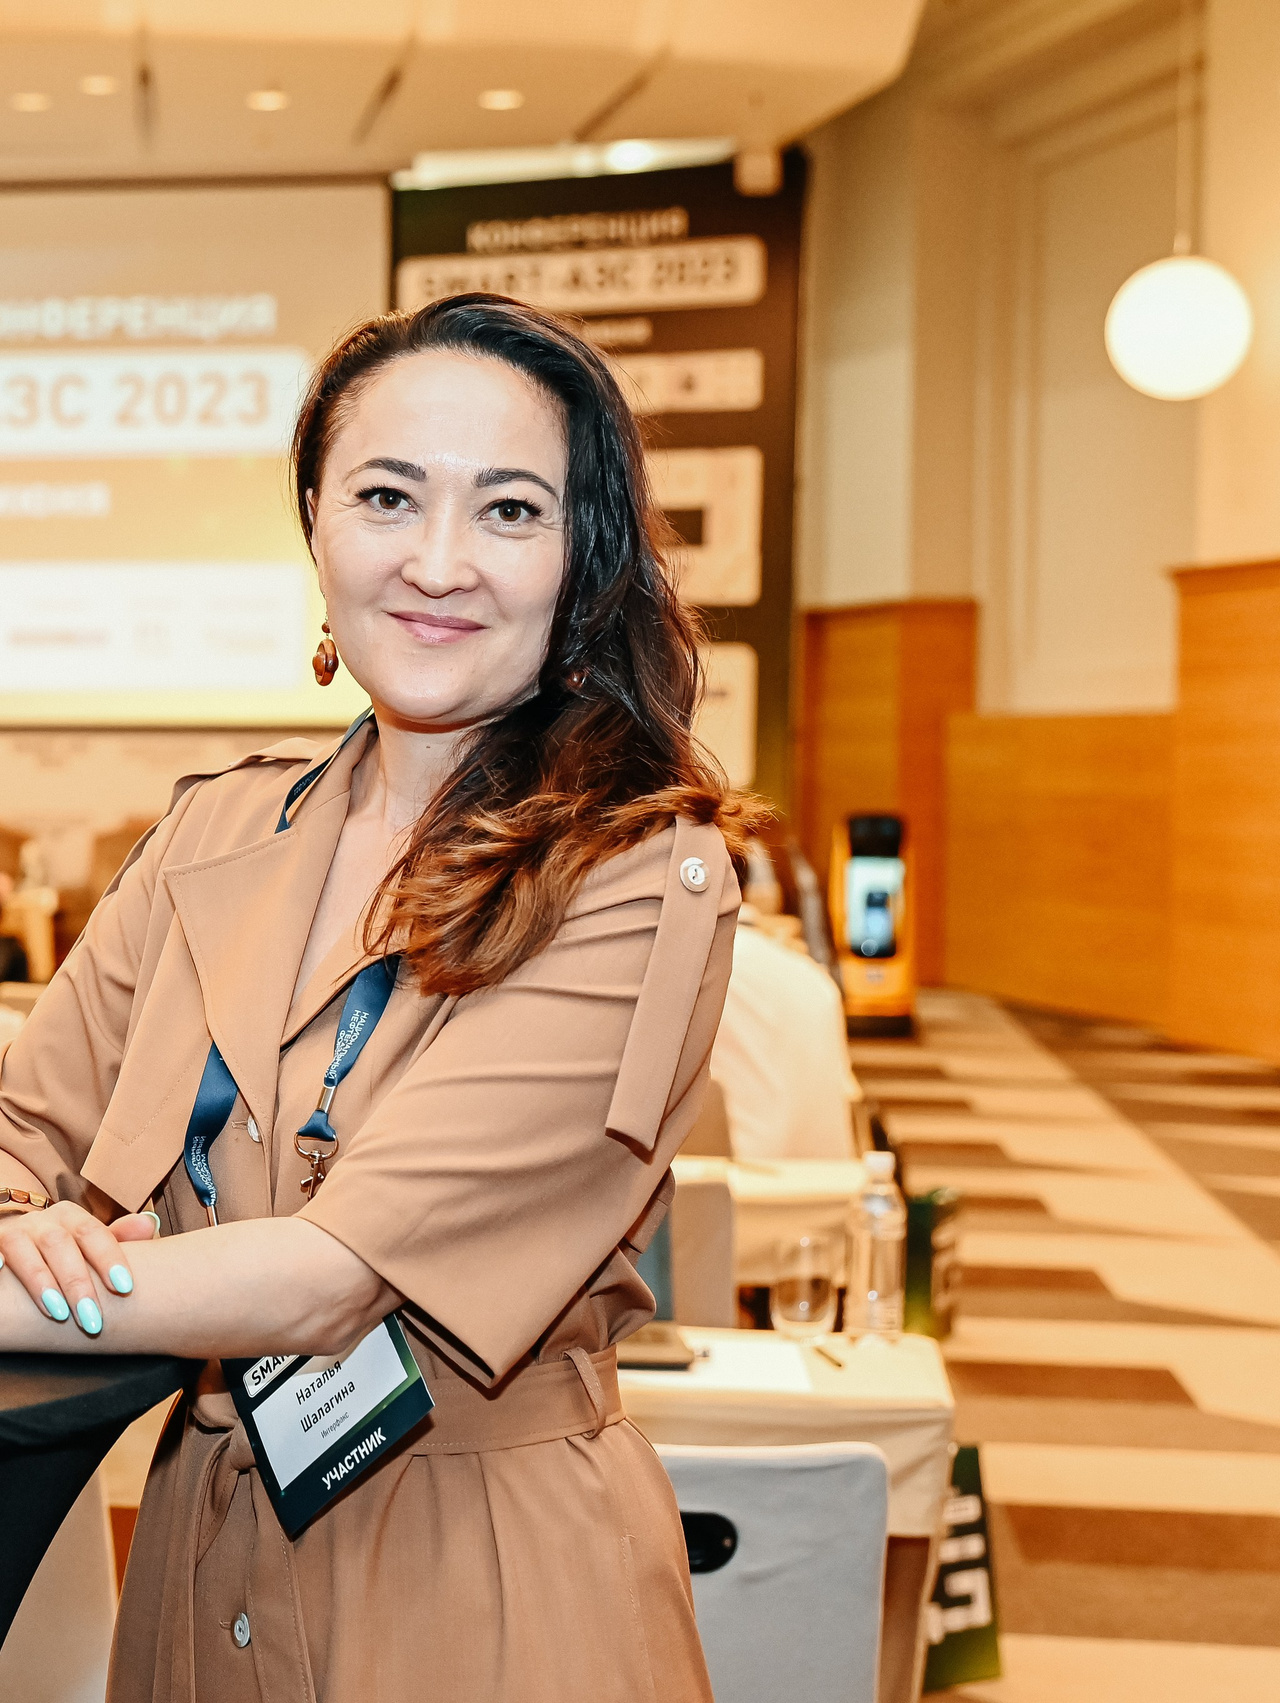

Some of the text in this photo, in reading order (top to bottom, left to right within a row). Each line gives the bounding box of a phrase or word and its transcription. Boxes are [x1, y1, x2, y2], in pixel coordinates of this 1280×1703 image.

[113, 369, 271, 429] 2023
[251, 1355, 290, 1386] SMA
[296, 1360, 342, 1405] Наталья
[300, 1381, 356, 1433] Шалагина
[321, 1412, 350, 1438] Интерфакс
[321, 1427, 387, 1491] УЧАСТНИК
